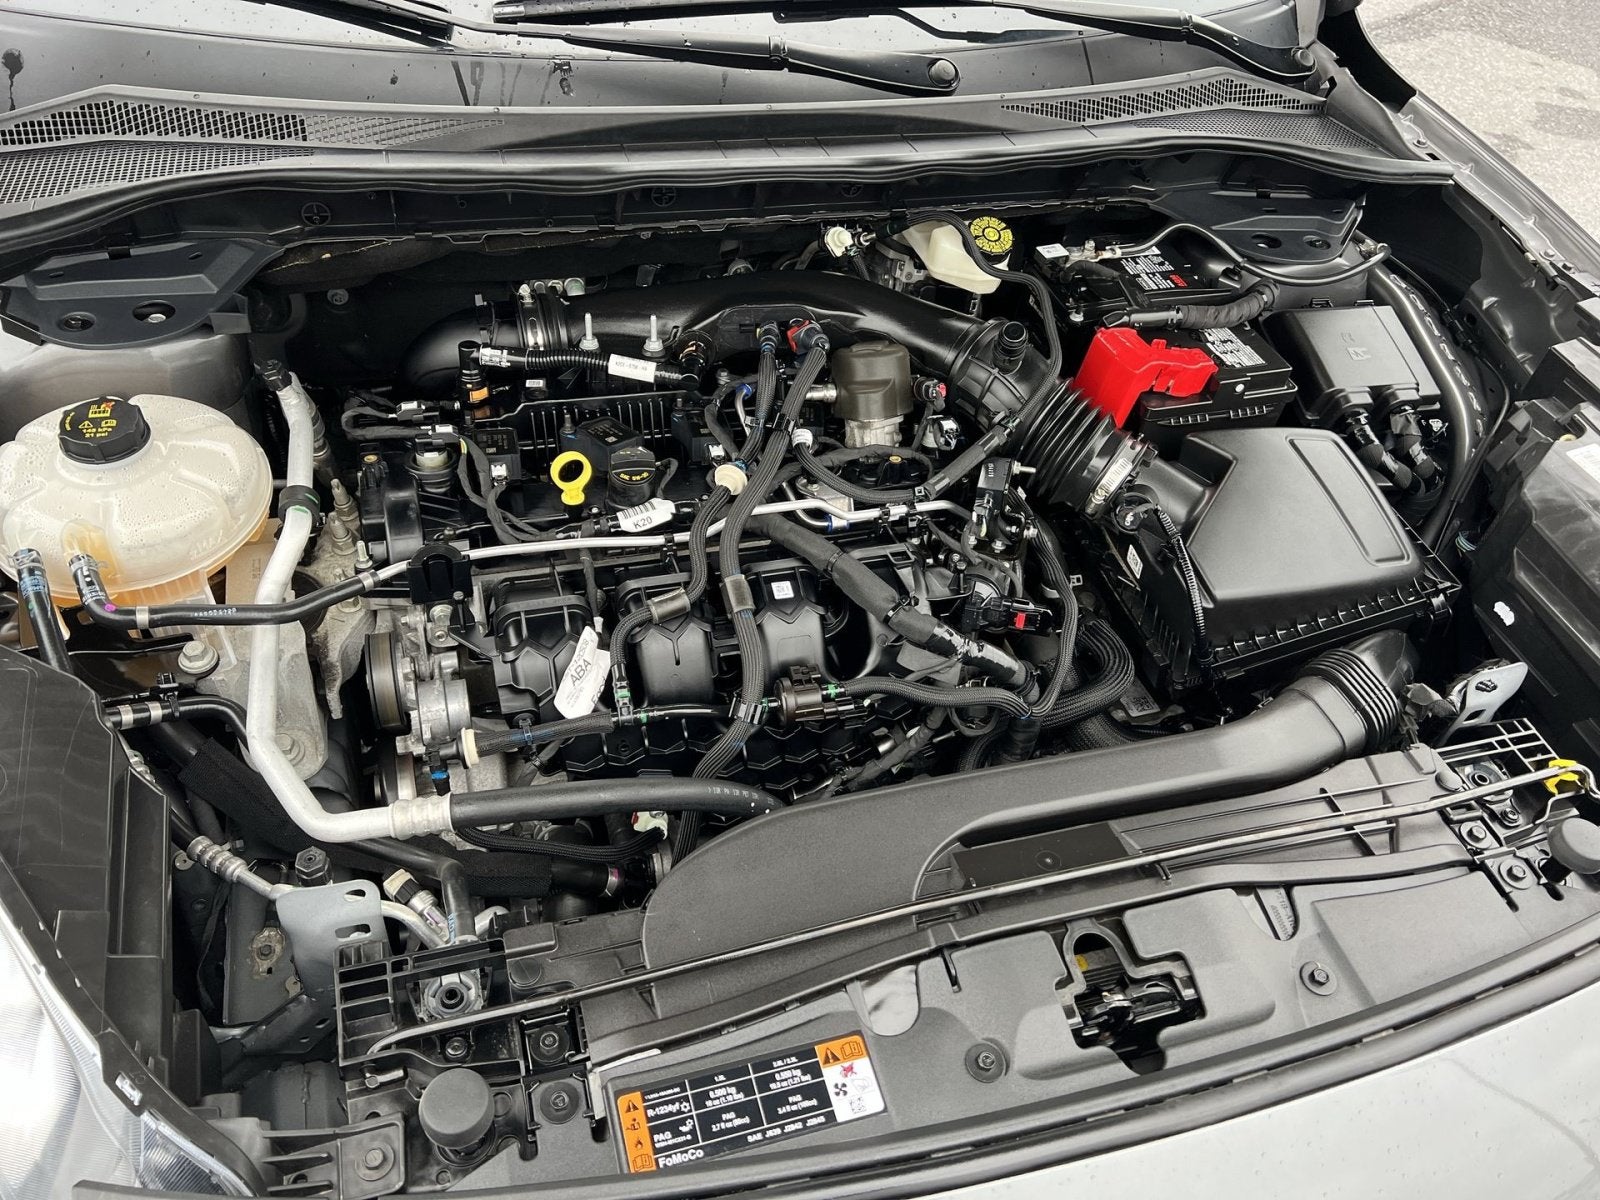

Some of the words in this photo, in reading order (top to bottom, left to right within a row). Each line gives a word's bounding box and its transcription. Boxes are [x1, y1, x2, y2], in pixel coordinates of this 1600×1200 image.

[633, 515, 653, 530] K20
[570, 658, 592, 687] ABA
[646, 1101, 680, 1118] R-1234yf
[721, 1111, 736, 1121] PAG
[711, 1123, 721, 1132] 2.7
[653, 1131, 673, 1143] PAG
[747, 1132, 764, 1143] SAE
[658, 1149, 705, 1169] FoMoCo
